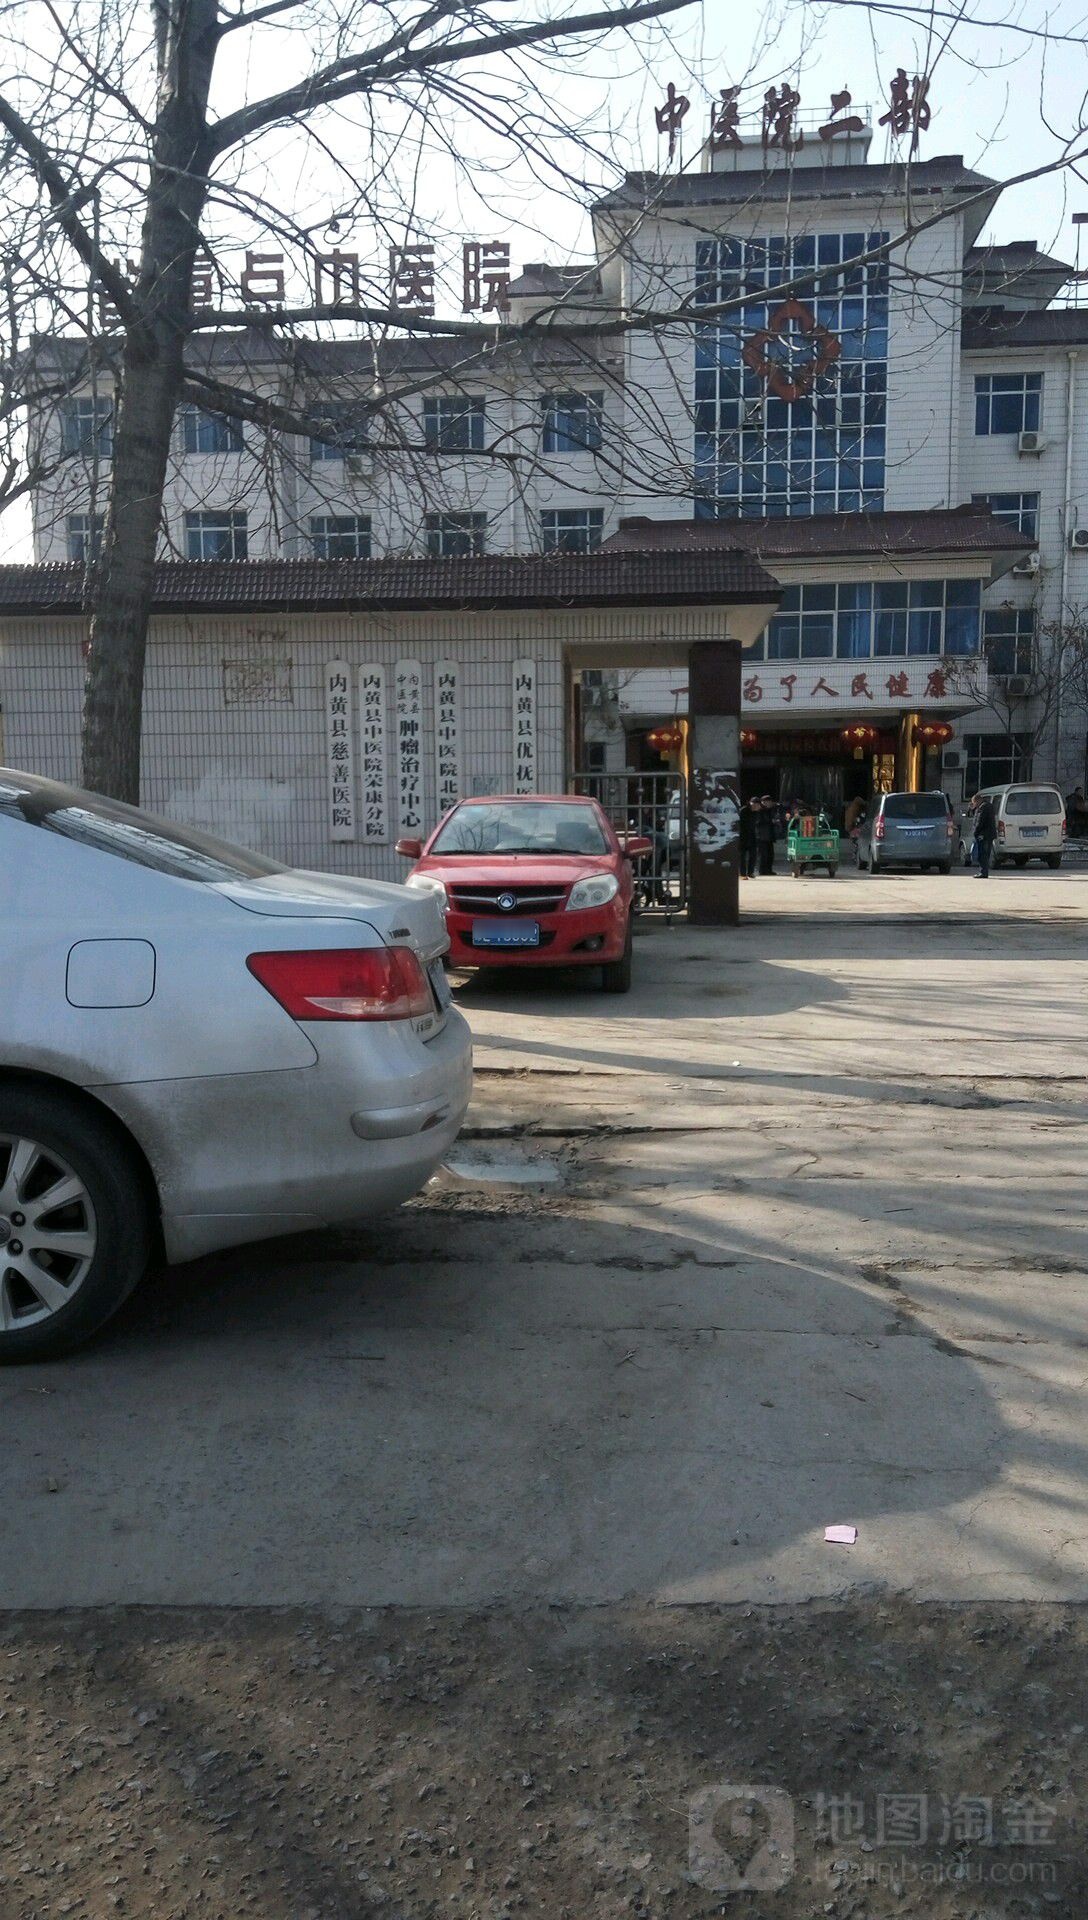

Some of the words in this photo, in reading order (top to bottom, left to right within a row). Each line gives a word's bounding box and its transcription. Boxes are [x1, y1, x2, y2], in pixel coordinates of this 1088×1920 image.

[655, 68, 931, 156] 中医院二部
[438, 673, 459, 816] 内黄县中医院北院
[670, 669, 949, 704] 一为了人民健康
[329, 673, 352, 828] 内黄县慈善医院
[363, 674, 385, 837] 内黄县中医院荣康分院
[399, 719, 421, 828] 肿瘤治疗中心
